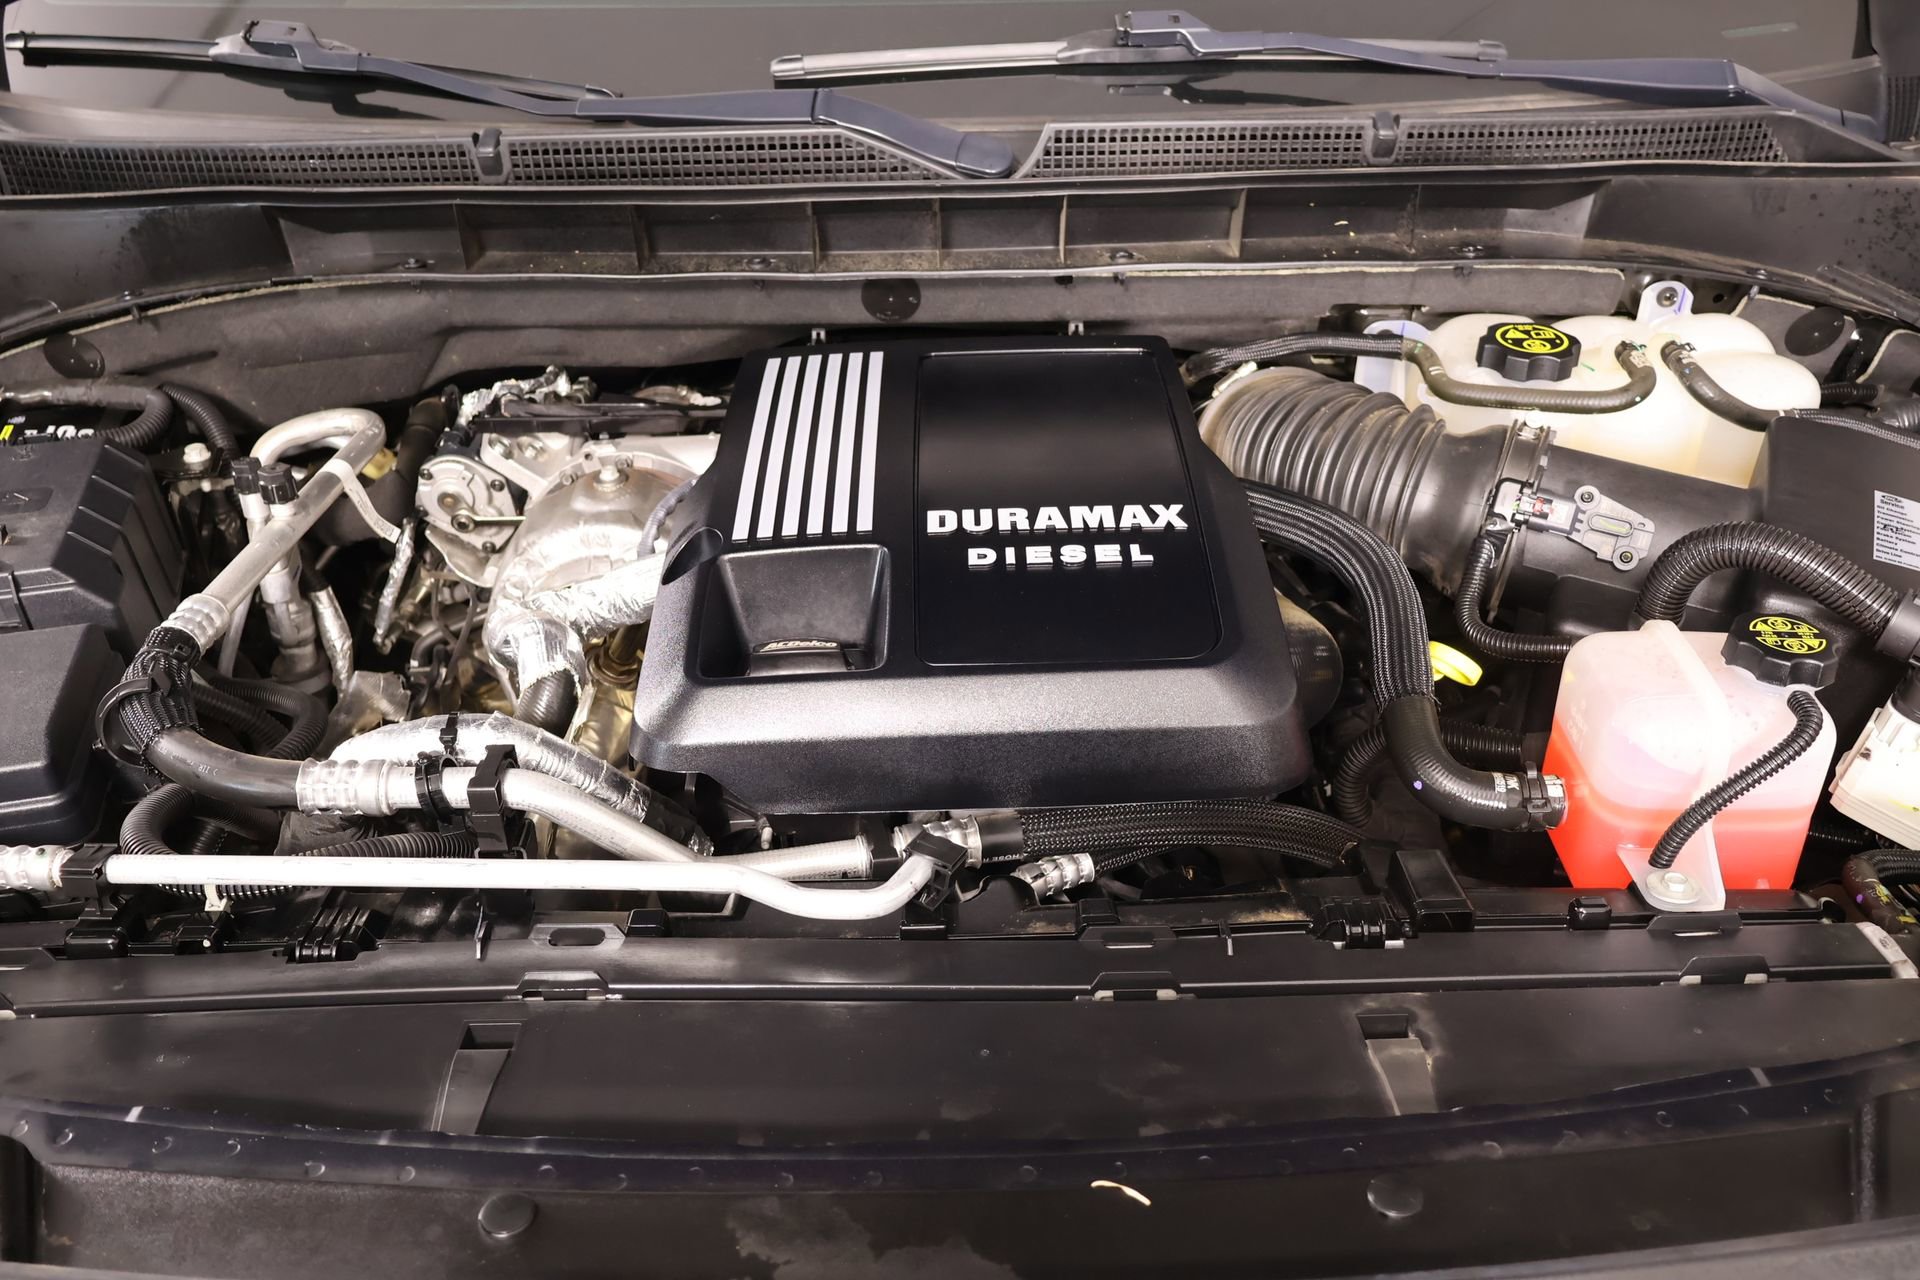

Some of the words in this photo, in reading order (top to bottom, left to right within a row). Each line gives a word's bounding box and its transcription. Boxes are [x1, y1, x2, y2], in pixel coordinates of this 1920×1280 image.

[1880, 499, 1905, 510] Service
[927, 504, 1189, 534] DURAMAX
[968, 544, 1154, 568] DIESEL
[760, 640, 838, 652] ACDelco
